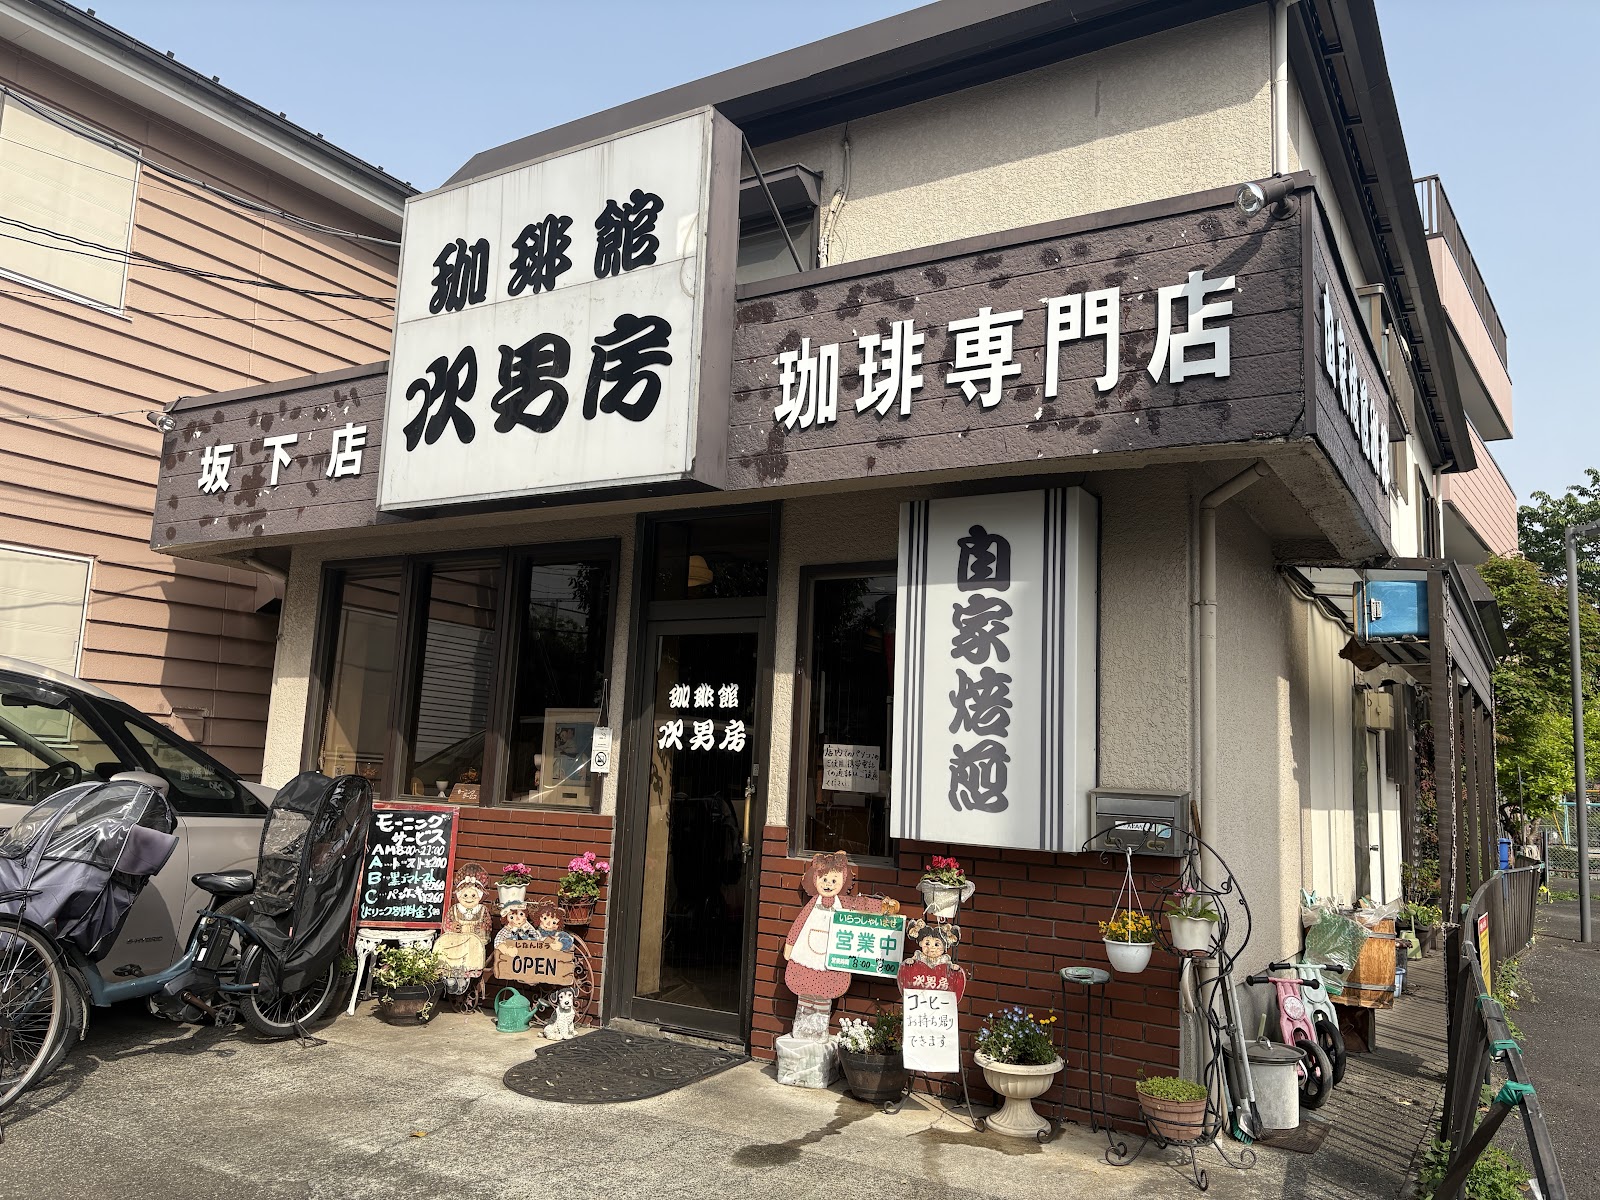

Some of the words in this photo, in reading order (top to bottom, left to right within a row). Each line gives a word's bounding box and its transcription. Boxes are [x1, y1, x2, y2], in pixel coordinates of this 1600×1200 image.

[429, 189, 664, 314] 珈琲館
[774, 270, 1236, 430] 珈琲専門店
[403, 314, 672, 451] 次男房
[198, 422, 367, 493] 坂下店
[949, 524, 1013, 813] 自家焙煎
[669, 683, 739, 708] 珈琲館
[658, 719, 746, 752] 次男房
[375, 813, 451, 832] モーニング
[391, 829, 447, 847] サービス
[835, 929, 897, 956] 営業中
[512, 955, 557, 976] OPEN
[908, 994, 949, 1010] コーヒー
